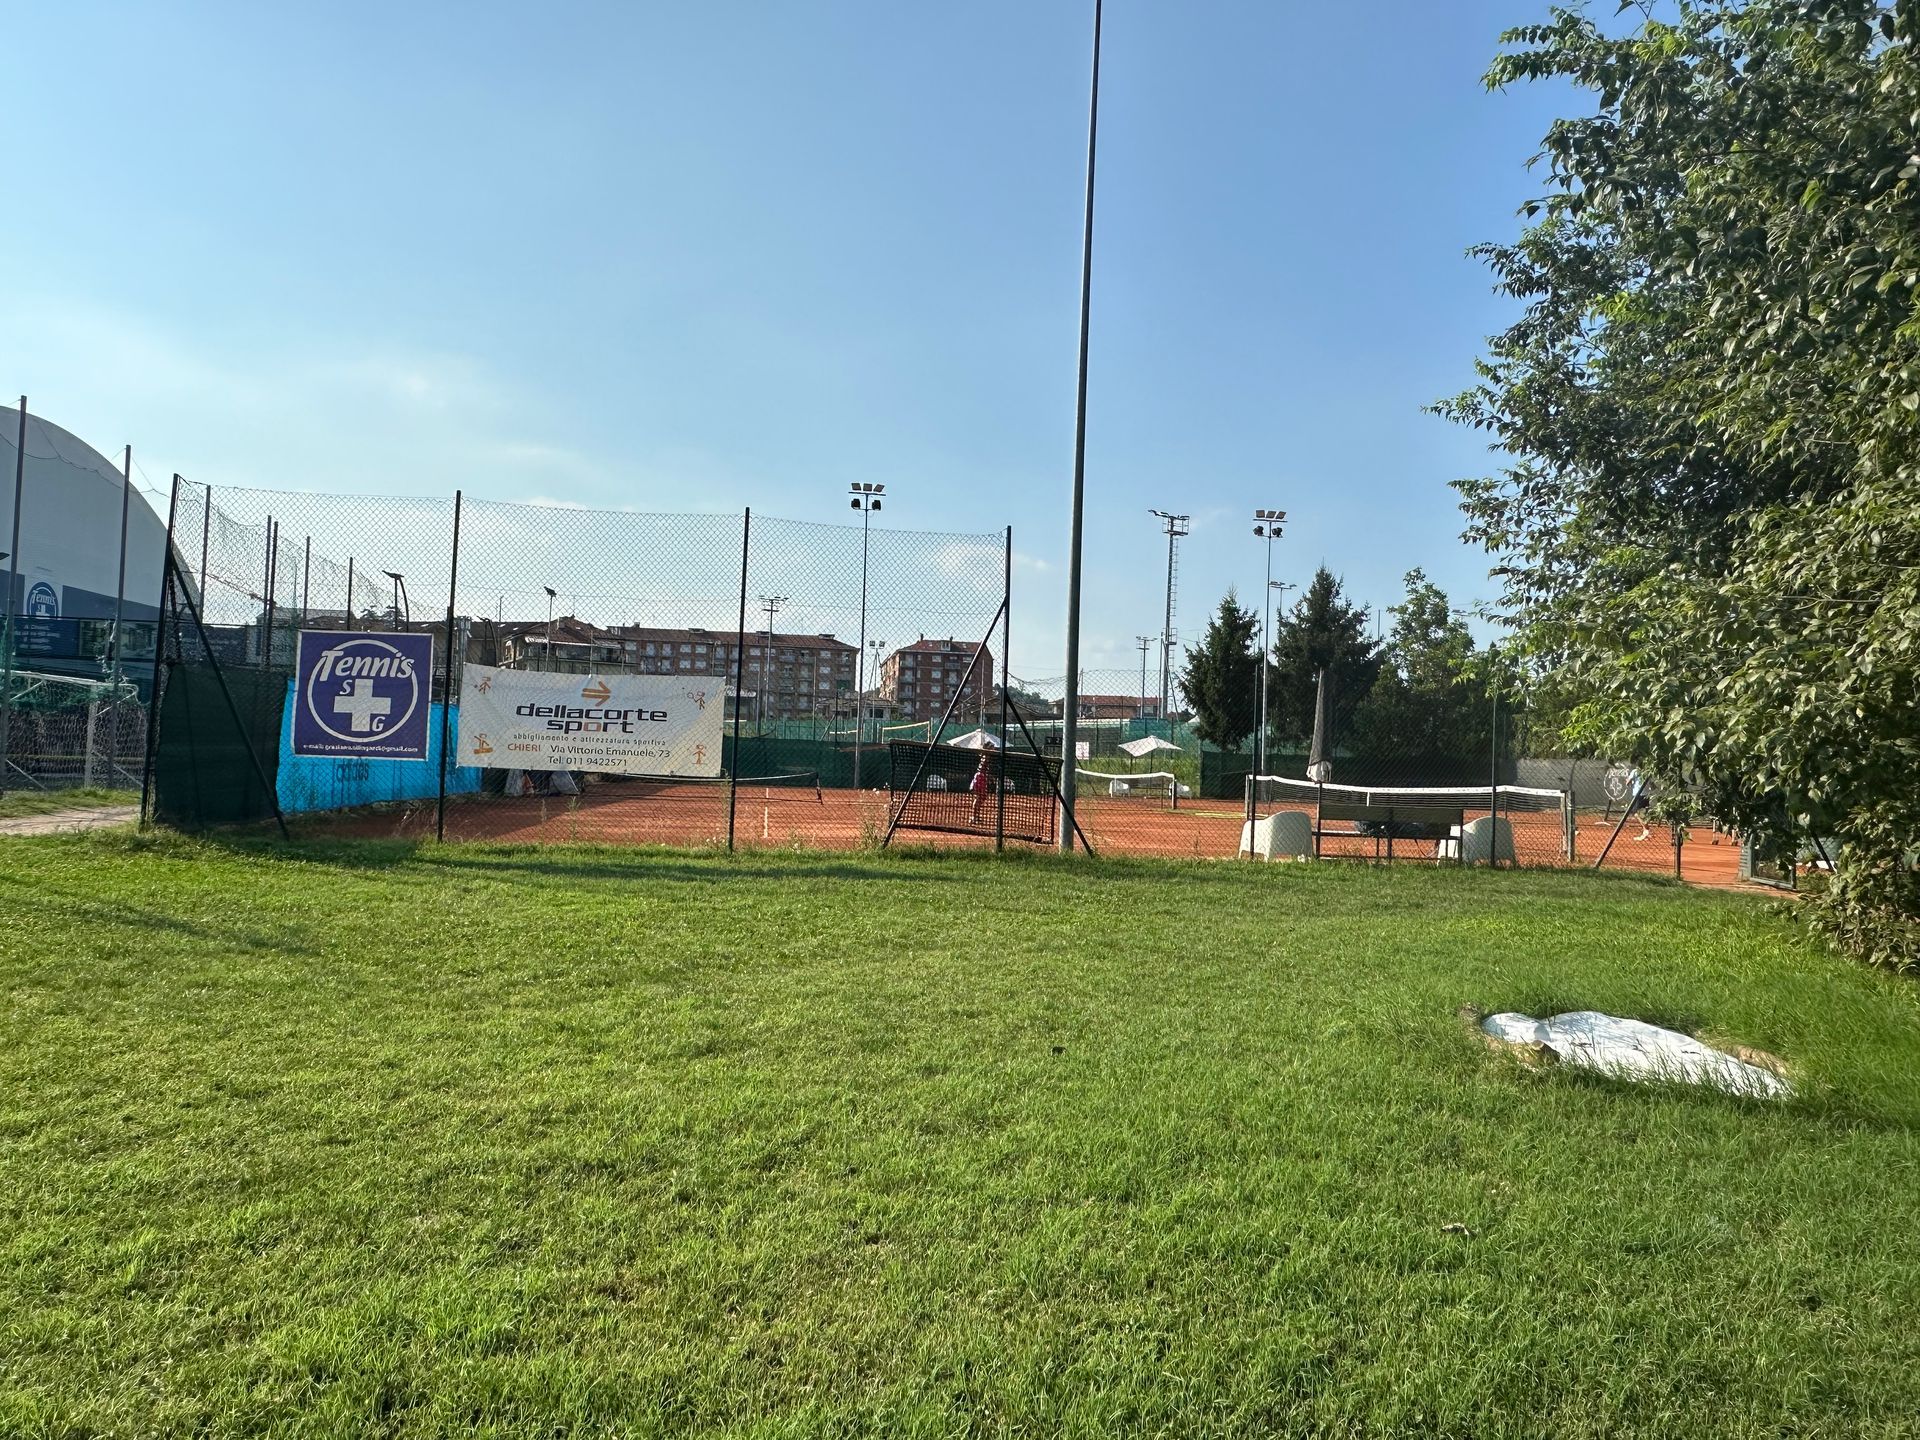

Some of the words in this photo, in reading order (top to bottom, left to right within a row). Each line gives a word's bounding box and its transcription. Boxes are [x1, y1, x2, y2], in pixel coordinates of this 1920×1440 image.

[319, 650, 415, 682] Tennis
[339, 679, 353, 695] S
[515, 703, 668, 722] dellacorte
[371, 716, 386, 732] G
[546, 719, 634, 735] sport
[513, 733, 569, 742] abbigliamento
[507, 742, 542, 752] CHIERI
[550, 744, 565, 754] Via
[567, 745, 604, 755] Vittorio
[659, 749, 671, 758] 73
[566, 757, 583, 765] 011
[586, 757, 627, 767] 9422571
